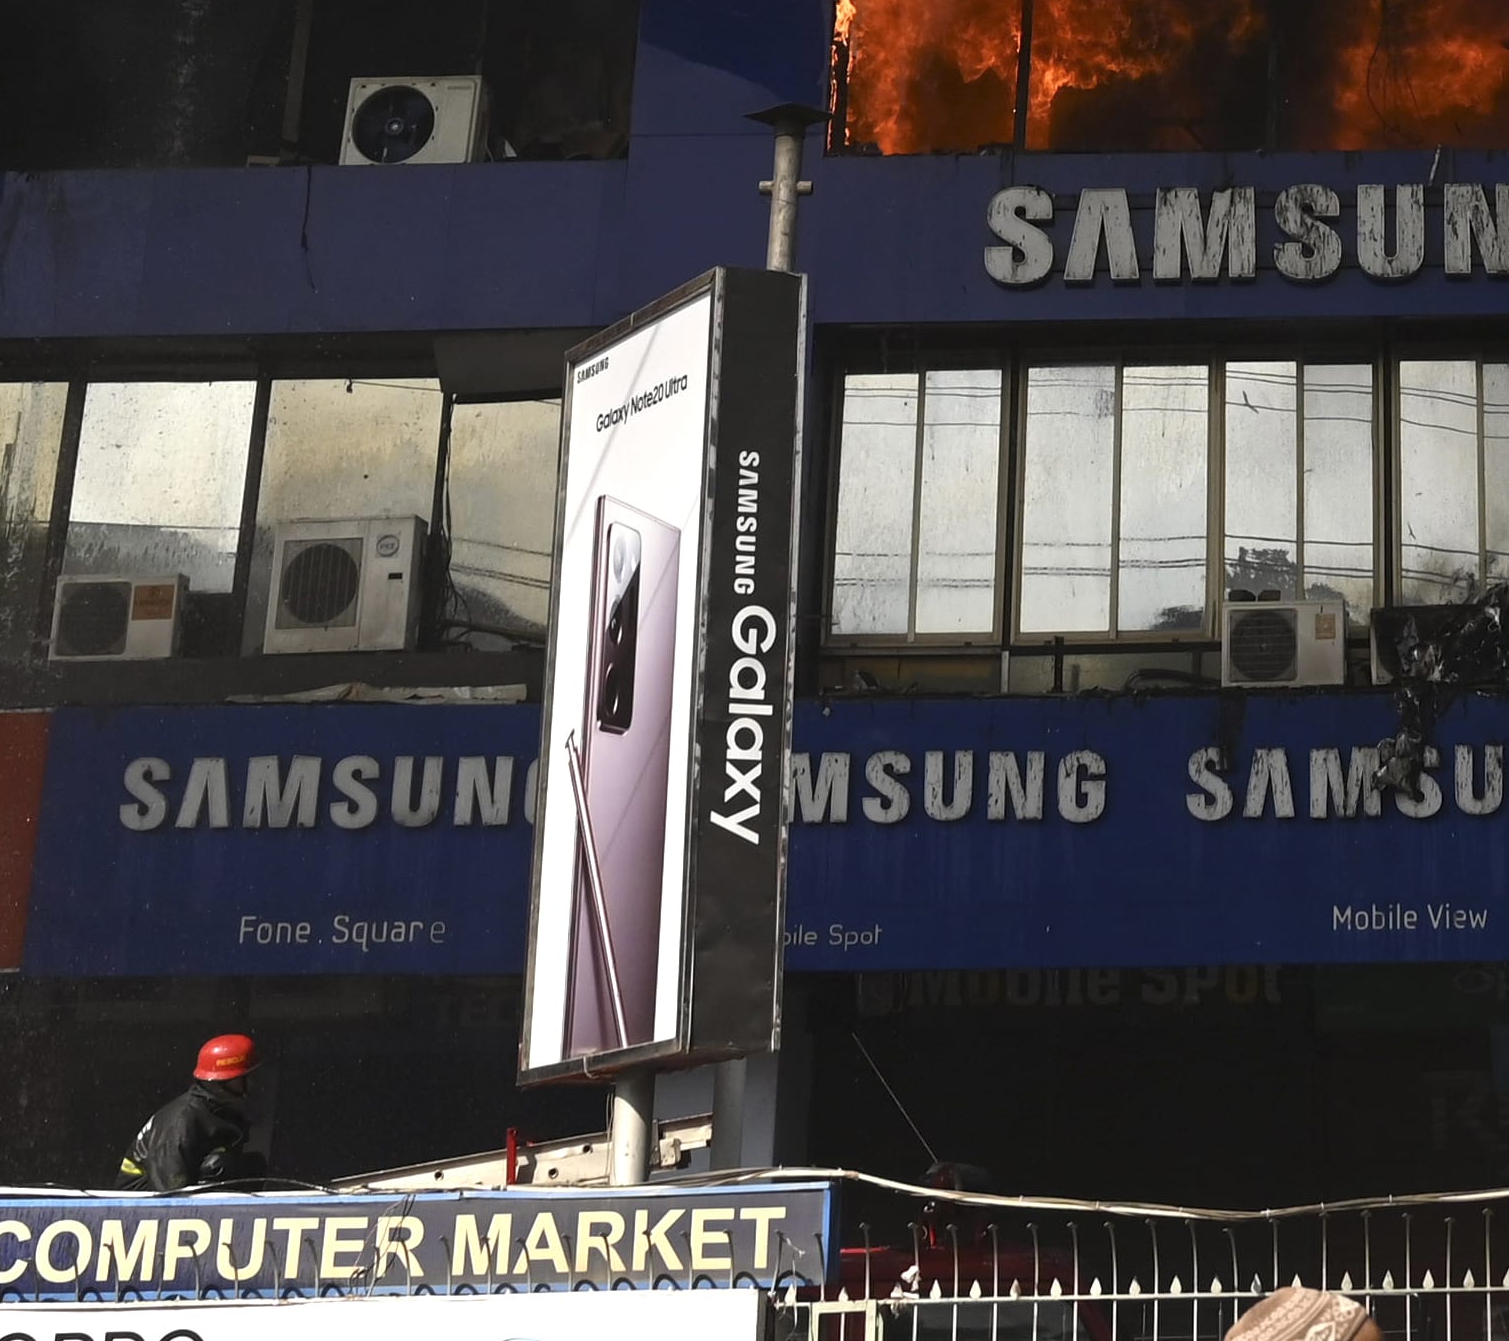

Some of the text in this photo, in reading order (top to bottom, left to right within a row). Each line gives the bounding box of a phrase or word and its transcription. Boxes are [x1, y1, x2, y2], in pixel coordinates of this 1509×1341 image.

[576, 356, 610, 384] SAMSUNG
[595, 370, 689, 433] Galaxy Note20 Ultra
[707, 449, 779, 846] SAMSUNG Galaxy
[119, 753, 539, 833] SAMSUN
[791, 750, 1110, 826] MSUNG
[238, 913, 449, 950] Fone Square
[827, 922, 883, 954] Spot
[1331, 901, 1490, 932] Mobile View
[451, 1205, 788, 1276] MARKET
